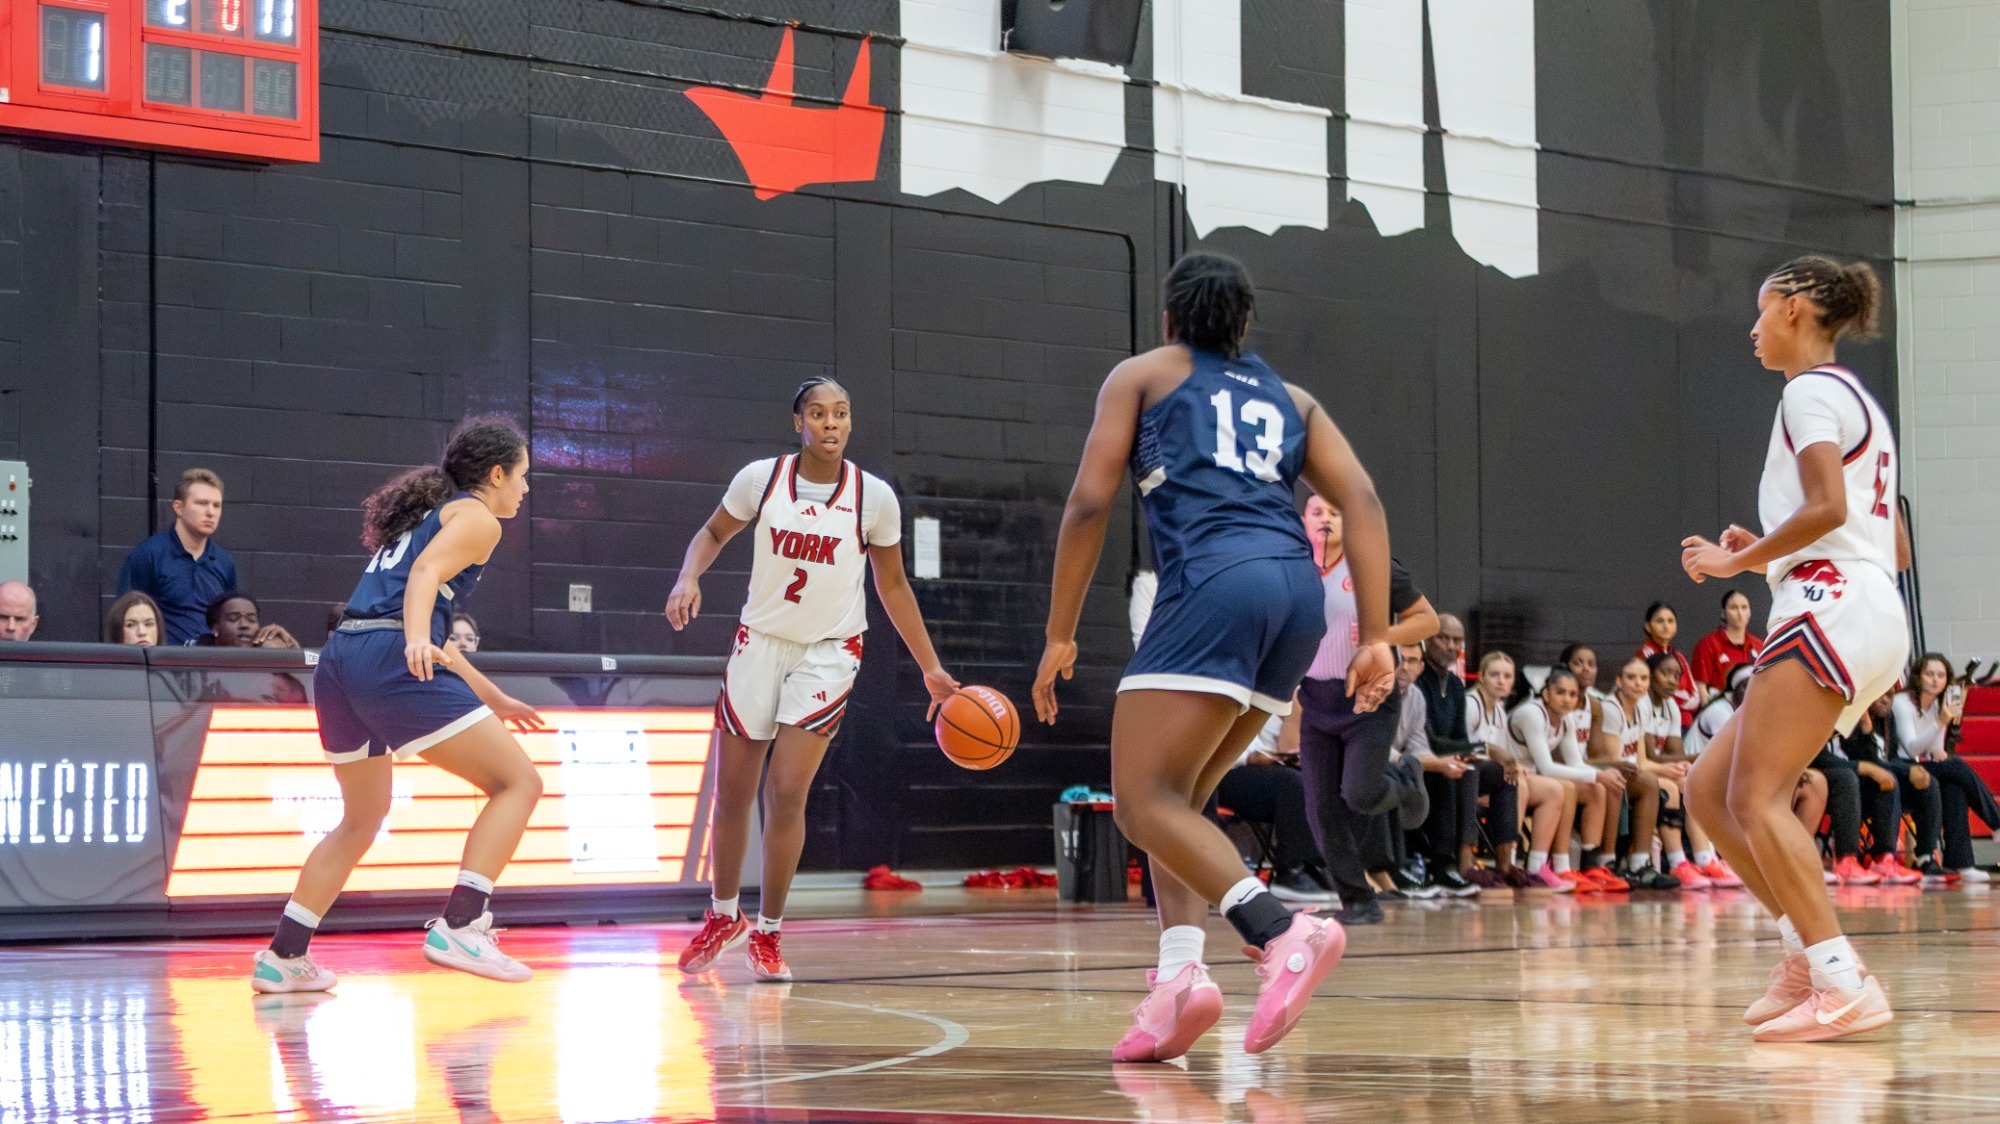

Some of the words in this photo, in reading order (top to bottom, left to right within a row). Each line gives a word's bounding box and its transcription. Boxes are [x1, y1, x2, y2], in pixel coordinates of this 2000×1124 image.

[1211, 388, 1284, 483] 13
[769, 526, 843, 566] YORK
[783, 567, 808, 604] 2
[1802, 584, 1825, 602] YU
